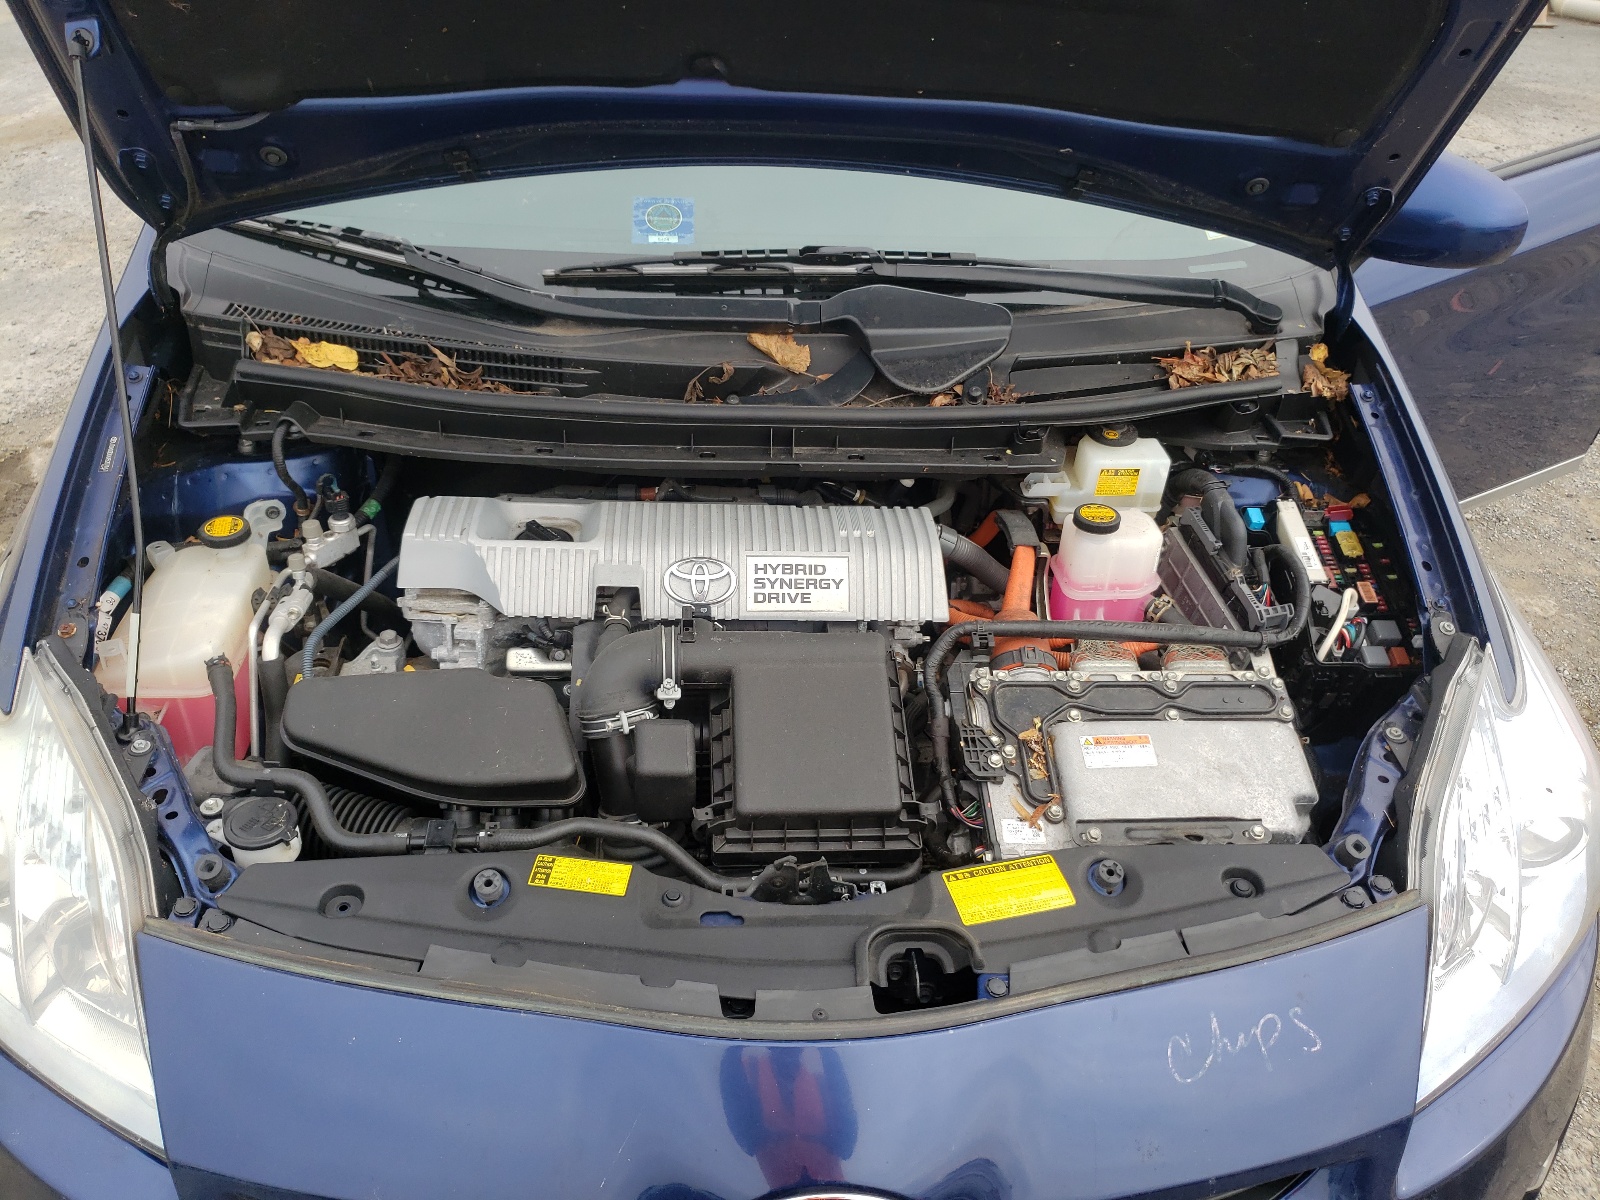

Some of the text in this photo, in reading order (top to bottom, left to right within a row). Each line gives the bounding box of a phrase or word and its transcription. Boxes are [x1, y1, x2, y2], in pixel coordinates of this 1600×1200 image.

[754, 563, 826, 575] HYBRID
[753, 578, 844, 590] SYNERGY
[753, 592, 812, 604] DRIVE
[973, 865, 1006, 877] CAUTION
[1008, 857, 1051, 870] ATTENTION
